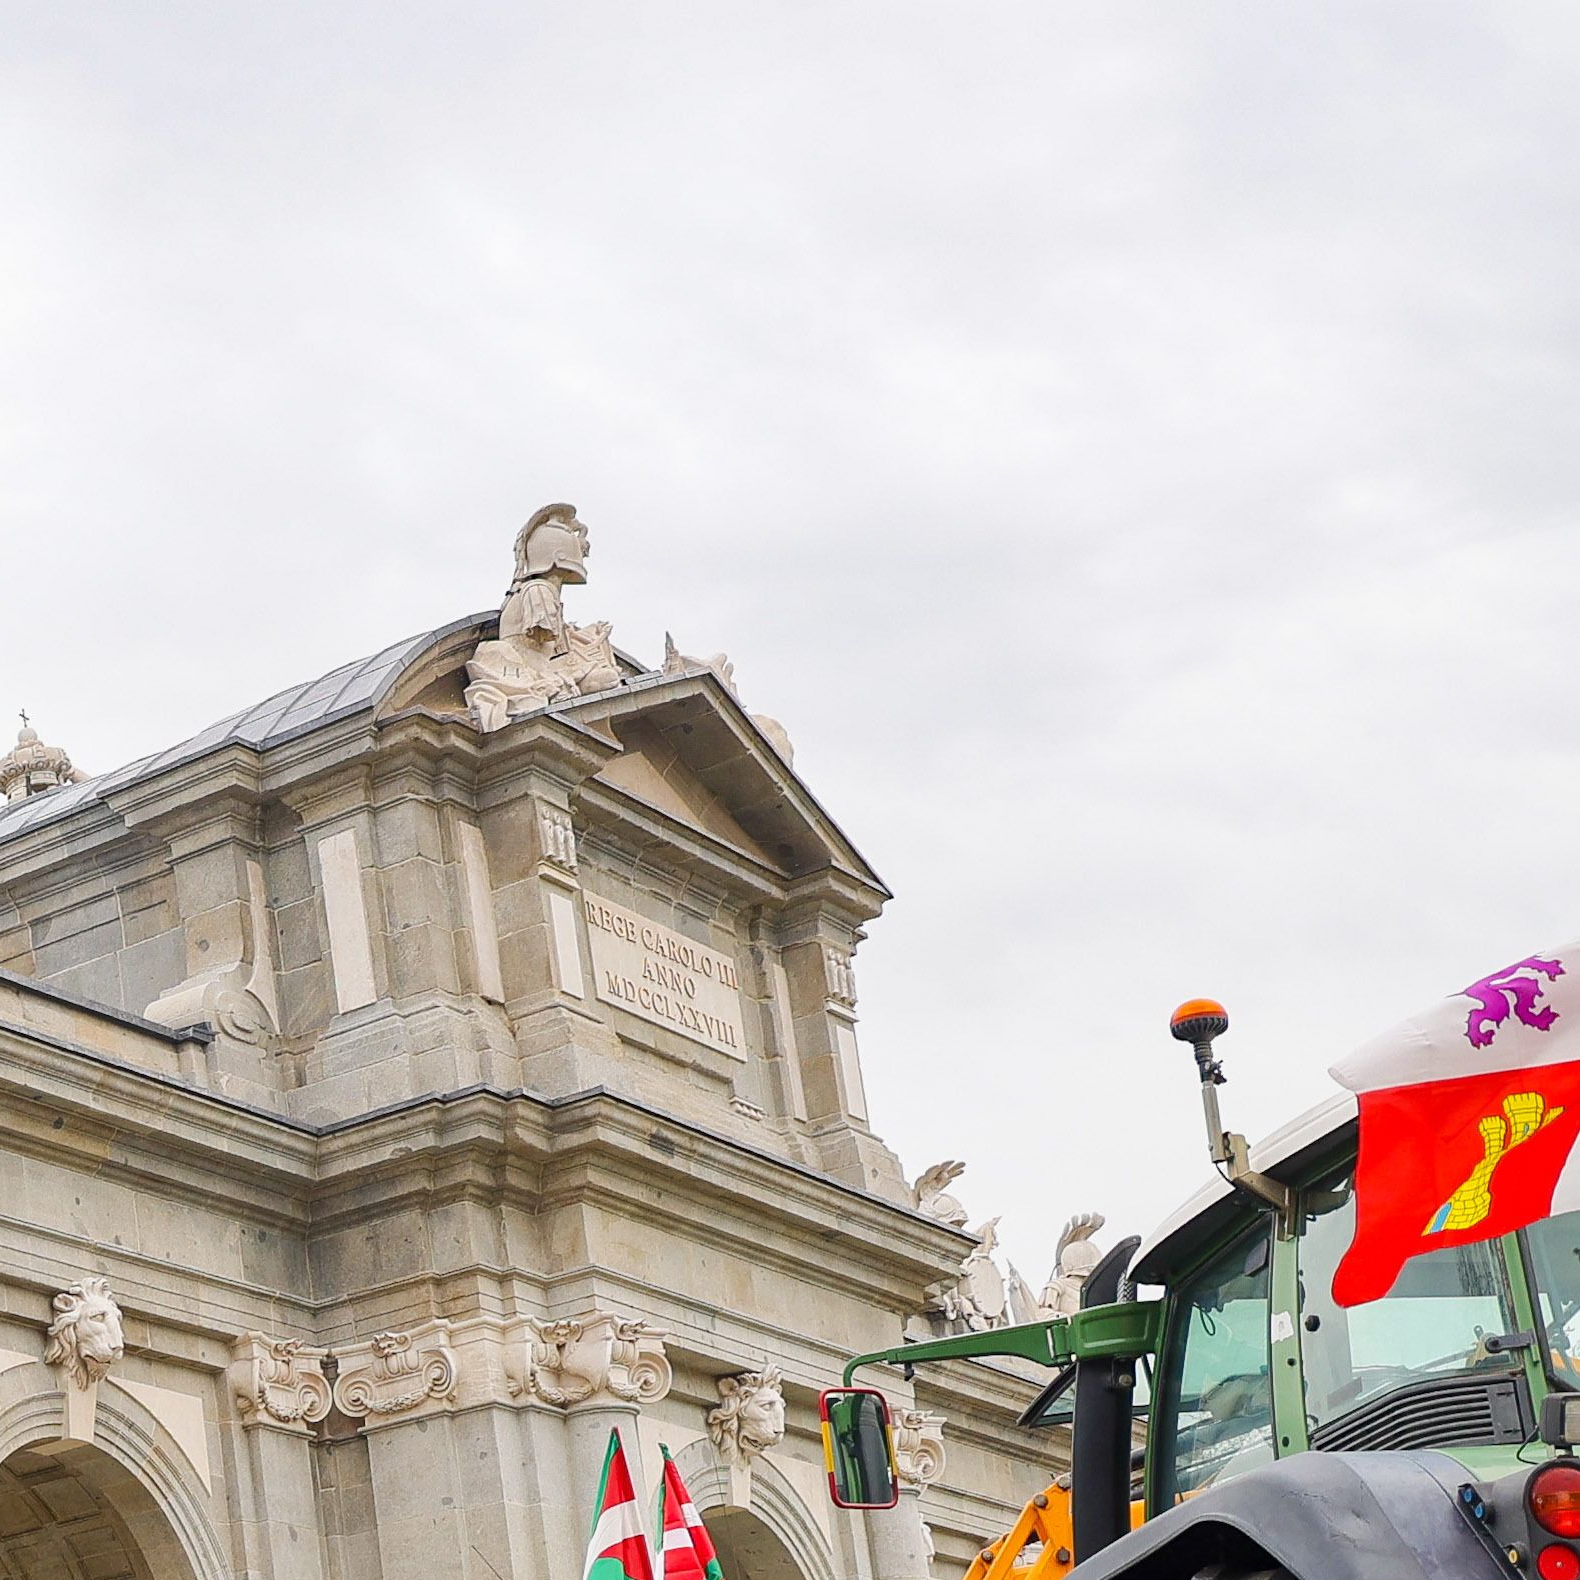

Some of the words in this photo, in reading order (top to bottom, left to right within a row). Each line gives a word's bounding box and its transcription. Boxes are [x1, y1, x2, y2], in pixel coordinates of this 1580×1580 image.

[585, 900, 637, 944] REGE
[641, 927, 713, 977] CAROLO
[716, 961, 739, 990] III
[641, 956, 698, 999] ANNO
[605, 970, 738, 1048] MDCCLXXVIII
